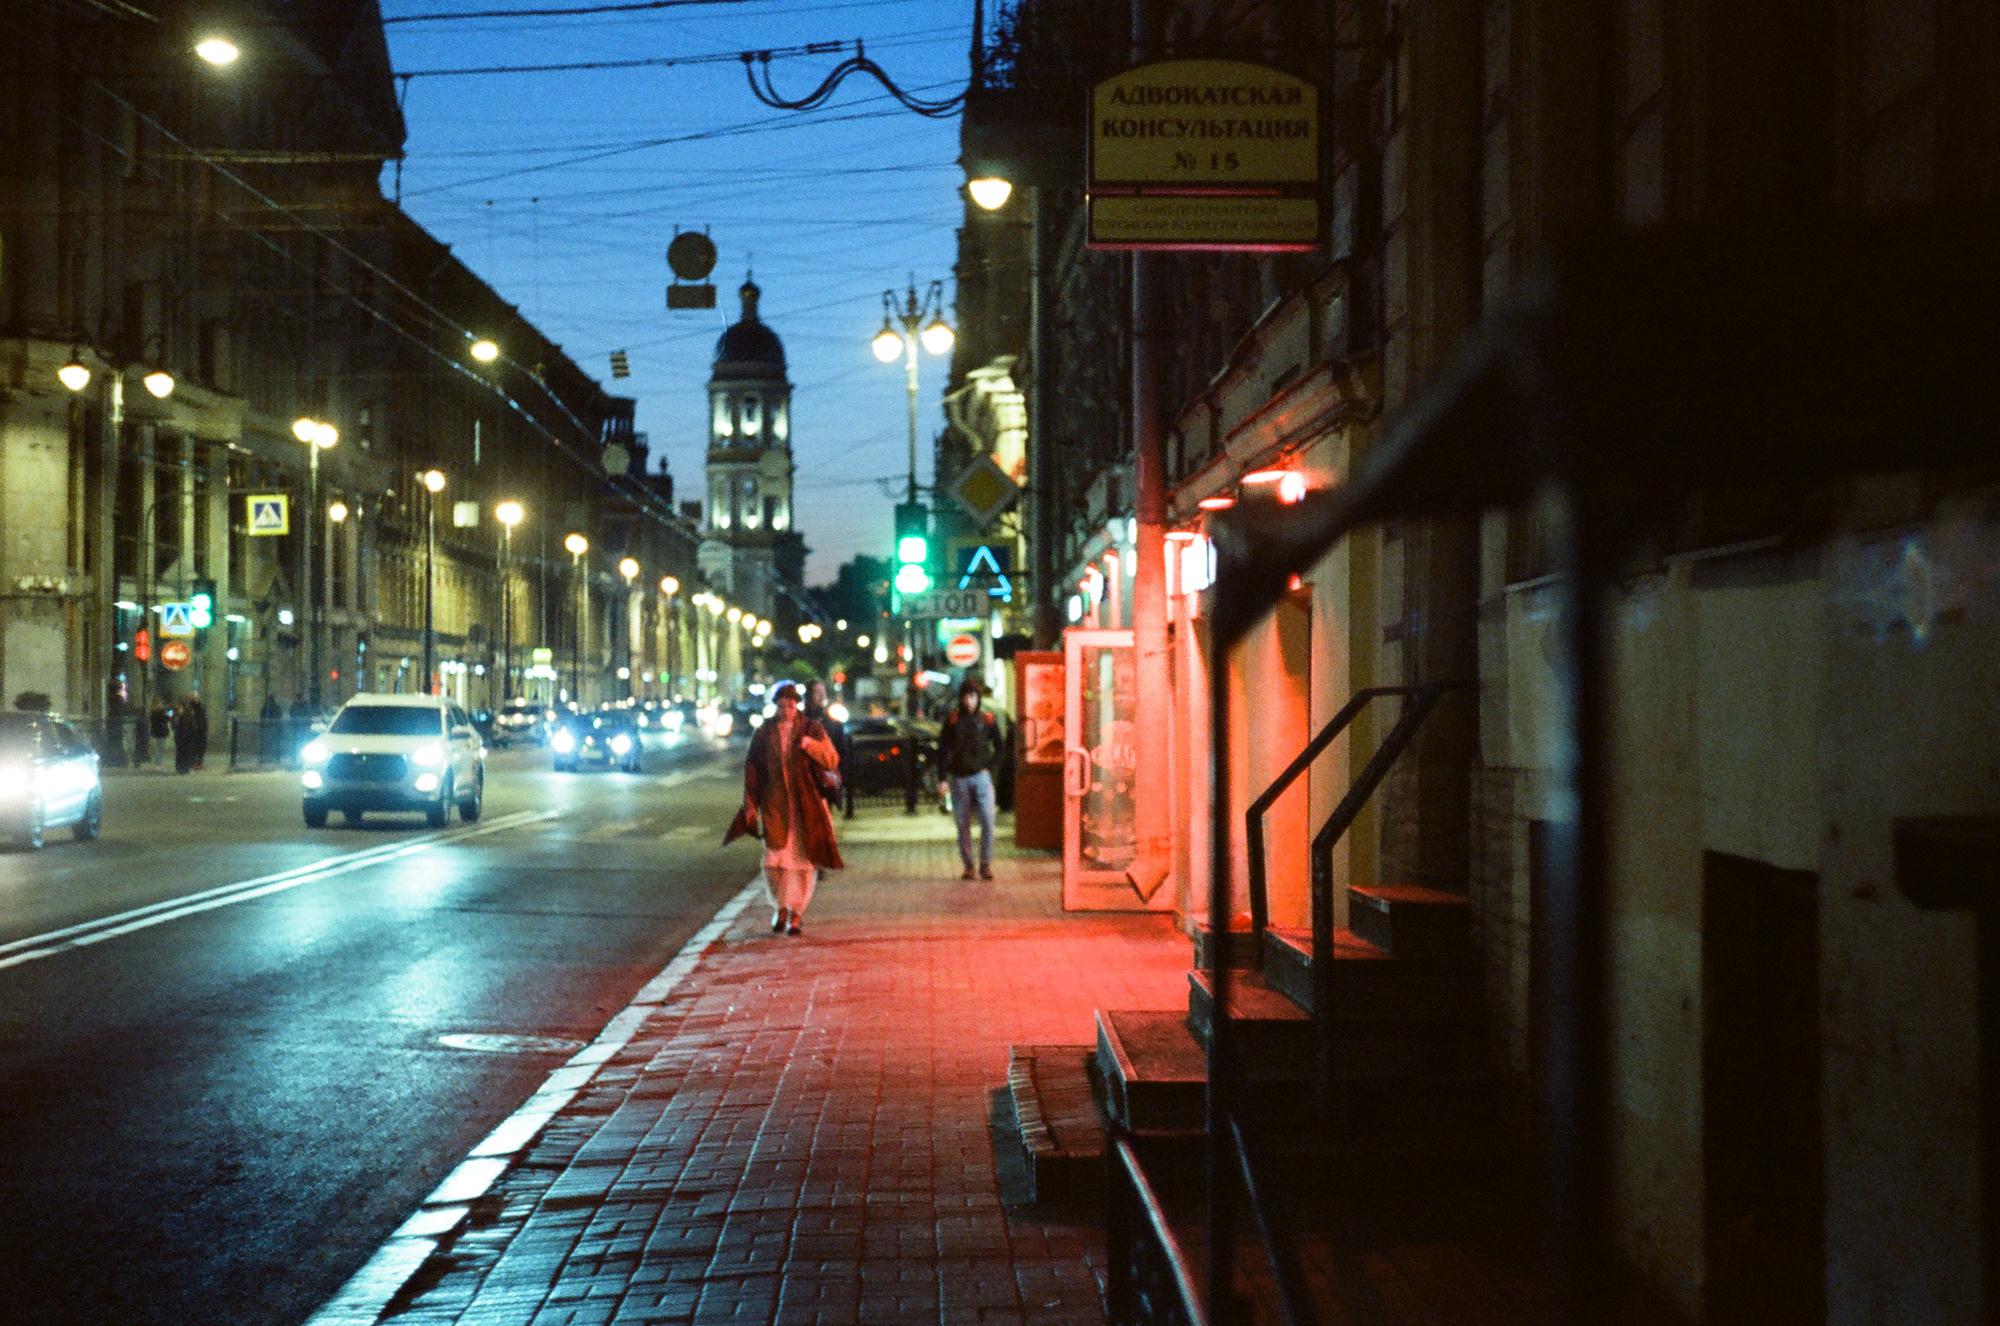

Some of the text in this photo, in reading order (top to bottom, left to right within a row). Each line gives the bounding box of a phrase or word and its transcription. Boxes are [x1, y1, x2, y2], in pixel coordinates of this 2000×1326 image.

[1111, 86, 1302, 105] АДВОКАТСКАЯ
[1102, 119, 1309, 138] КОНСУЛЬТАЦИЯ
[1172, 151, 1239, 170] № 15
